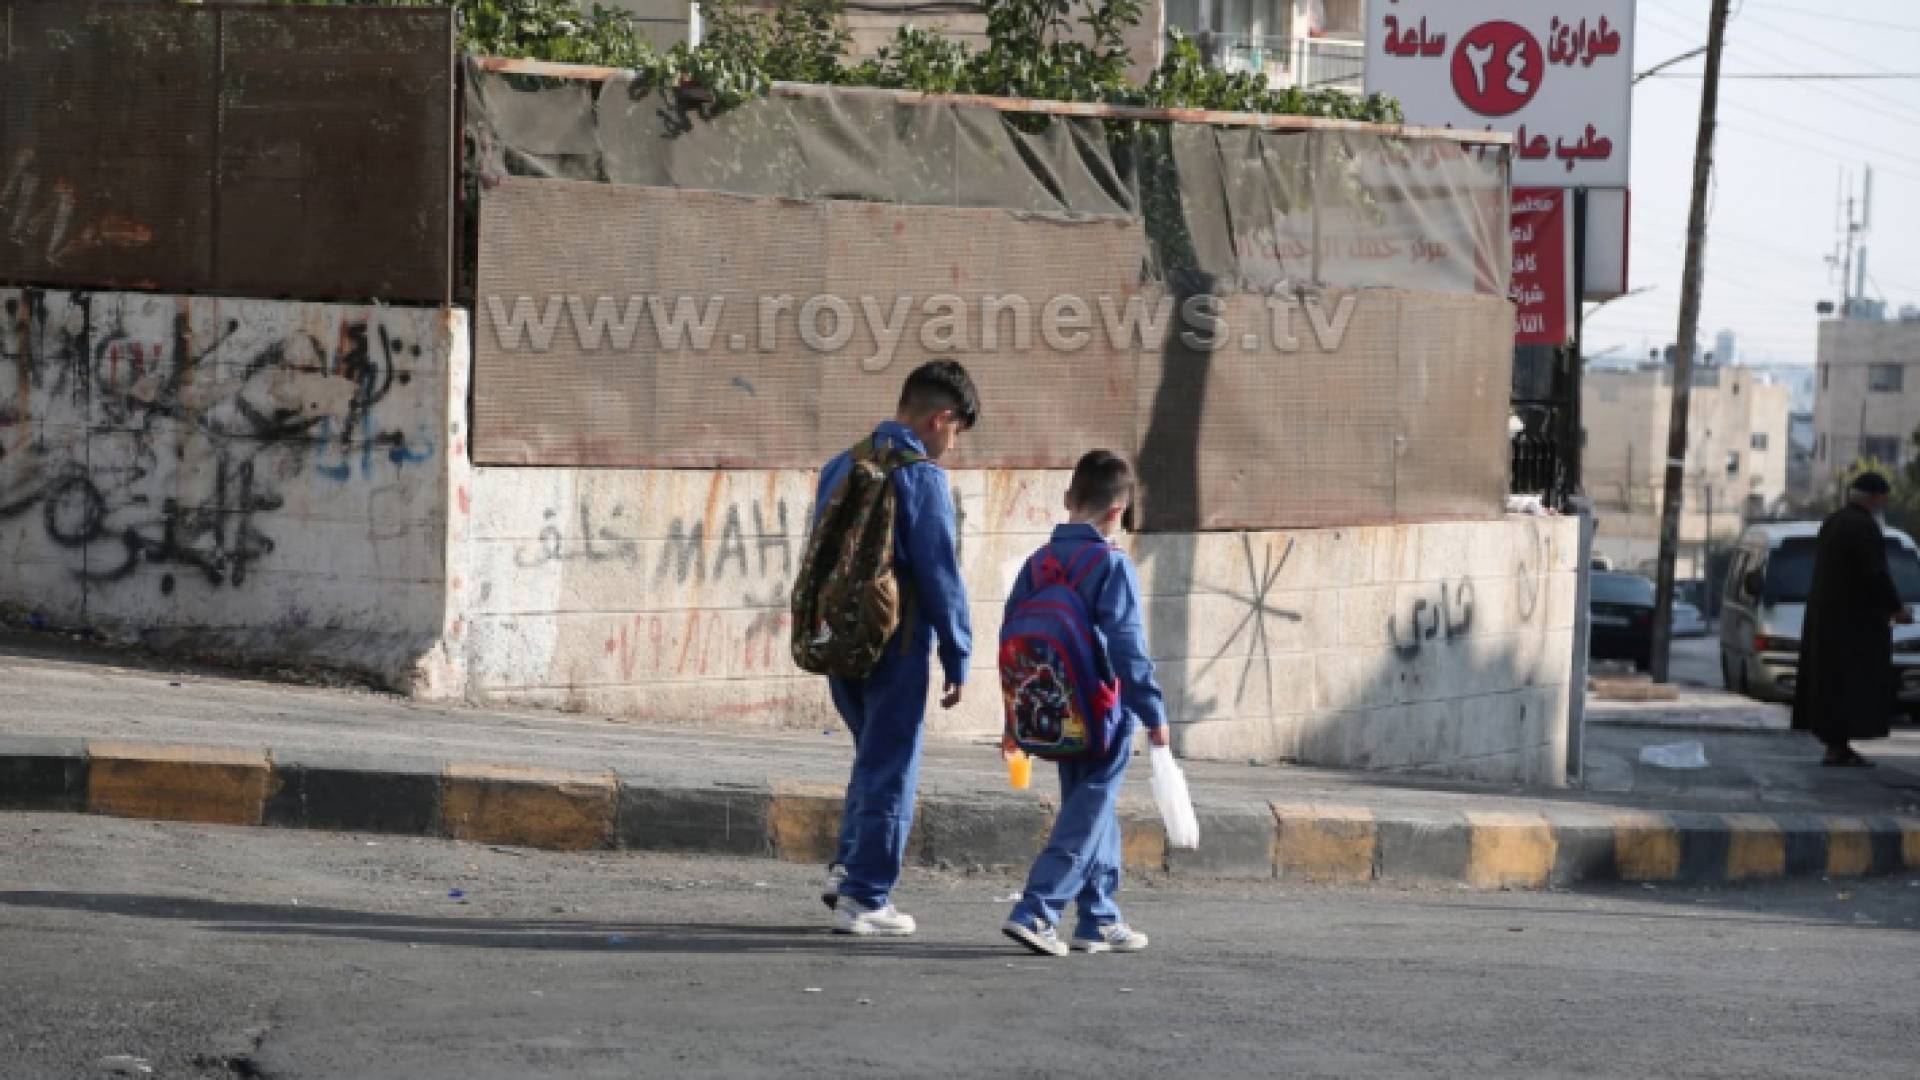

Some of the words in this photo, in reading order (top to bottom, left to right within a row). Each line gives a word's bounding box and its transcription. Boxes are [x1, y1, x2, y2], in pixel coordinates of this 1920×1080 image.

[1384, 15, 1447, 57] ساعة
[1547, 15, 1621, 67] طوارئ
[1465, 40, 1530, 95] ٢٤
[1555, 123, 1613, 173] طب
